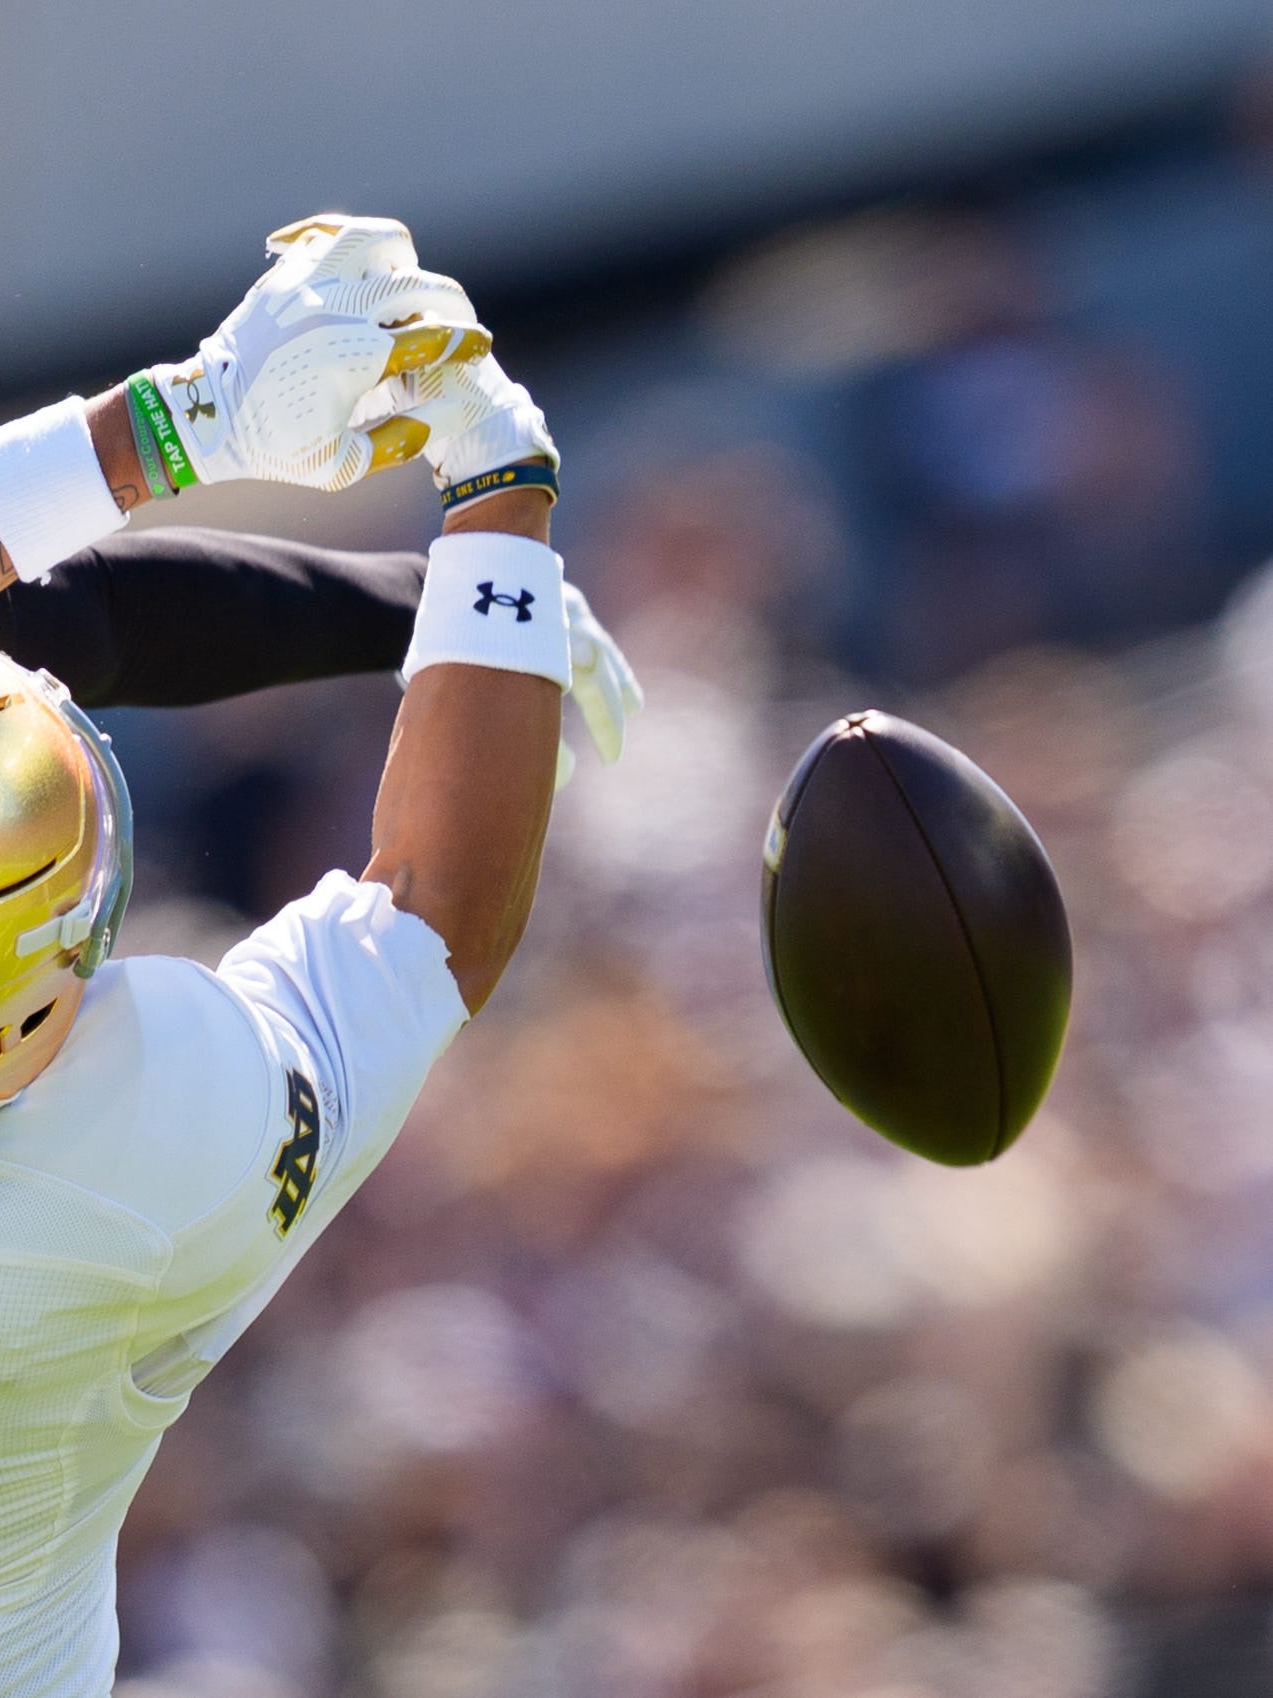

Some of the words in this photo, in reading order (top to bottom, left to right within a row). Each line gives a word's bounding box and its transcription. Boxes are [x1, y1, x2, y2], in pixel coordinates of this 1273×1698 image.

[151, 410, 172, 441] THE
[164, 441, 186, 473] TAP
[476, 472, 500, 489] LIFE
